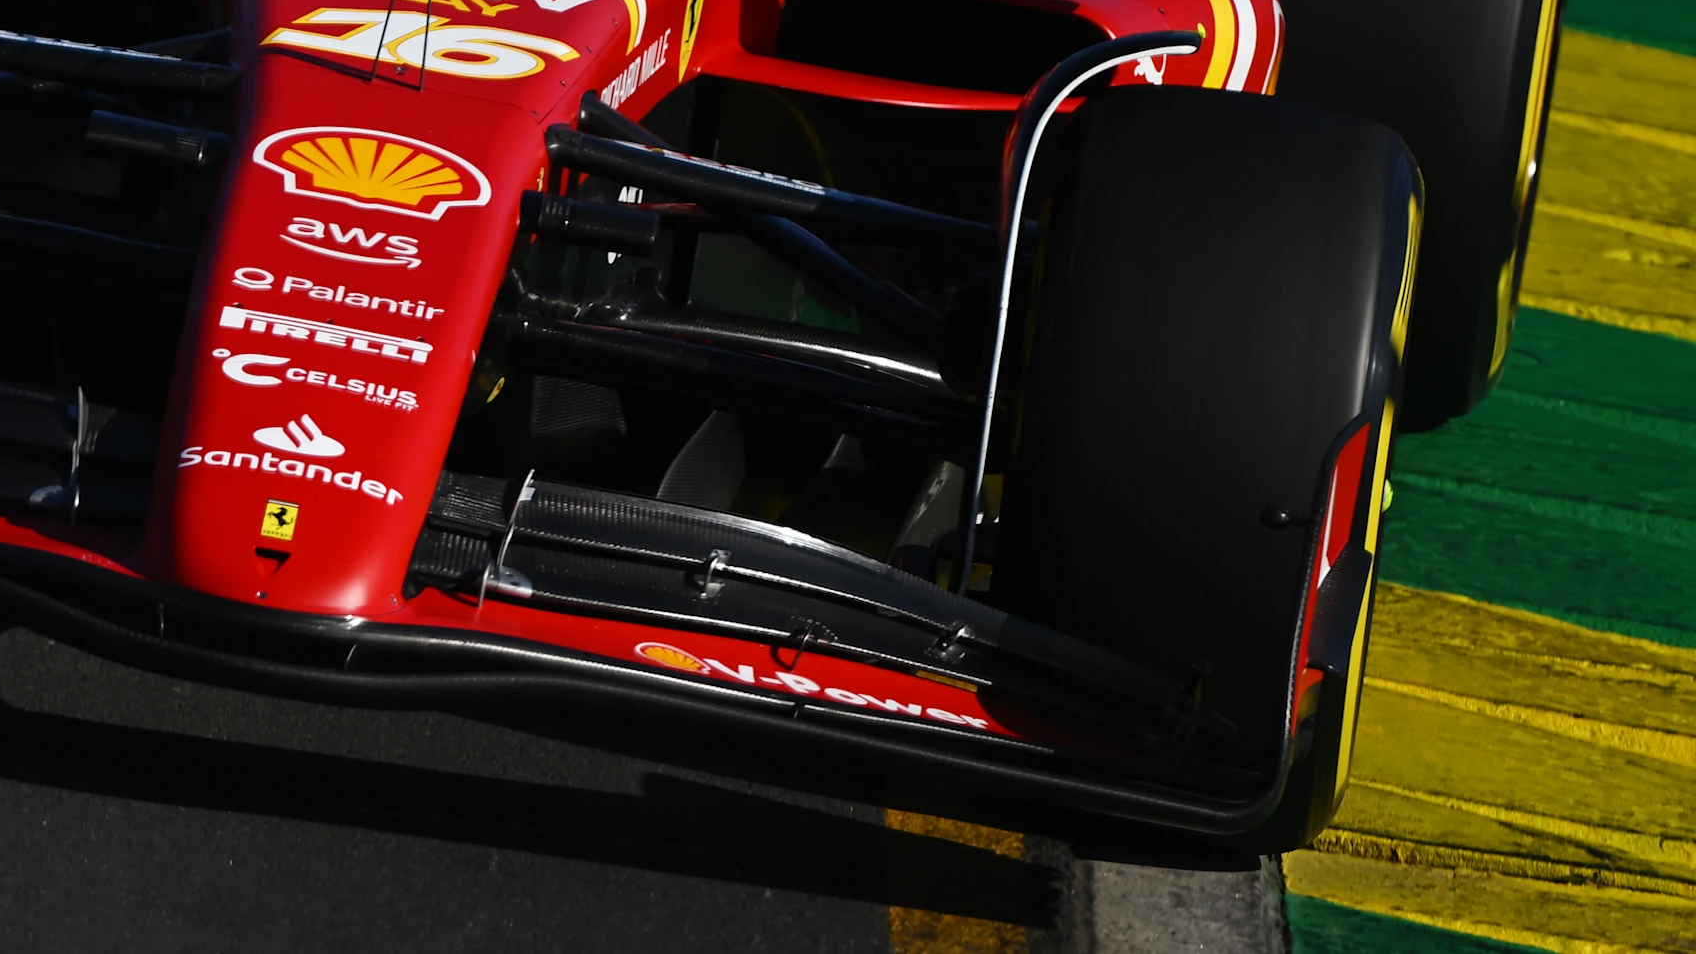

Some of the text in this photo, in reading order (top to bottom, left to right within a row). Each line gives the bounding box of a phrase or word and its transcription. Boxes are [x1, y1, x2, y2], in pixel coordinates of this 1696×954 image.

[259, 7, 581, 80] 16
[286, 215, 421, 257] aws
[281, 274, 446, 321] Palantir
[219, 305, 434, 364] PIRELLI
[286, 366, 418, 406] CELSIUS
[364, 394, 415, 413] LIVE FIT
[178, 445, 405, 507] Santander
[707, 656, 991, 731] V-Power
